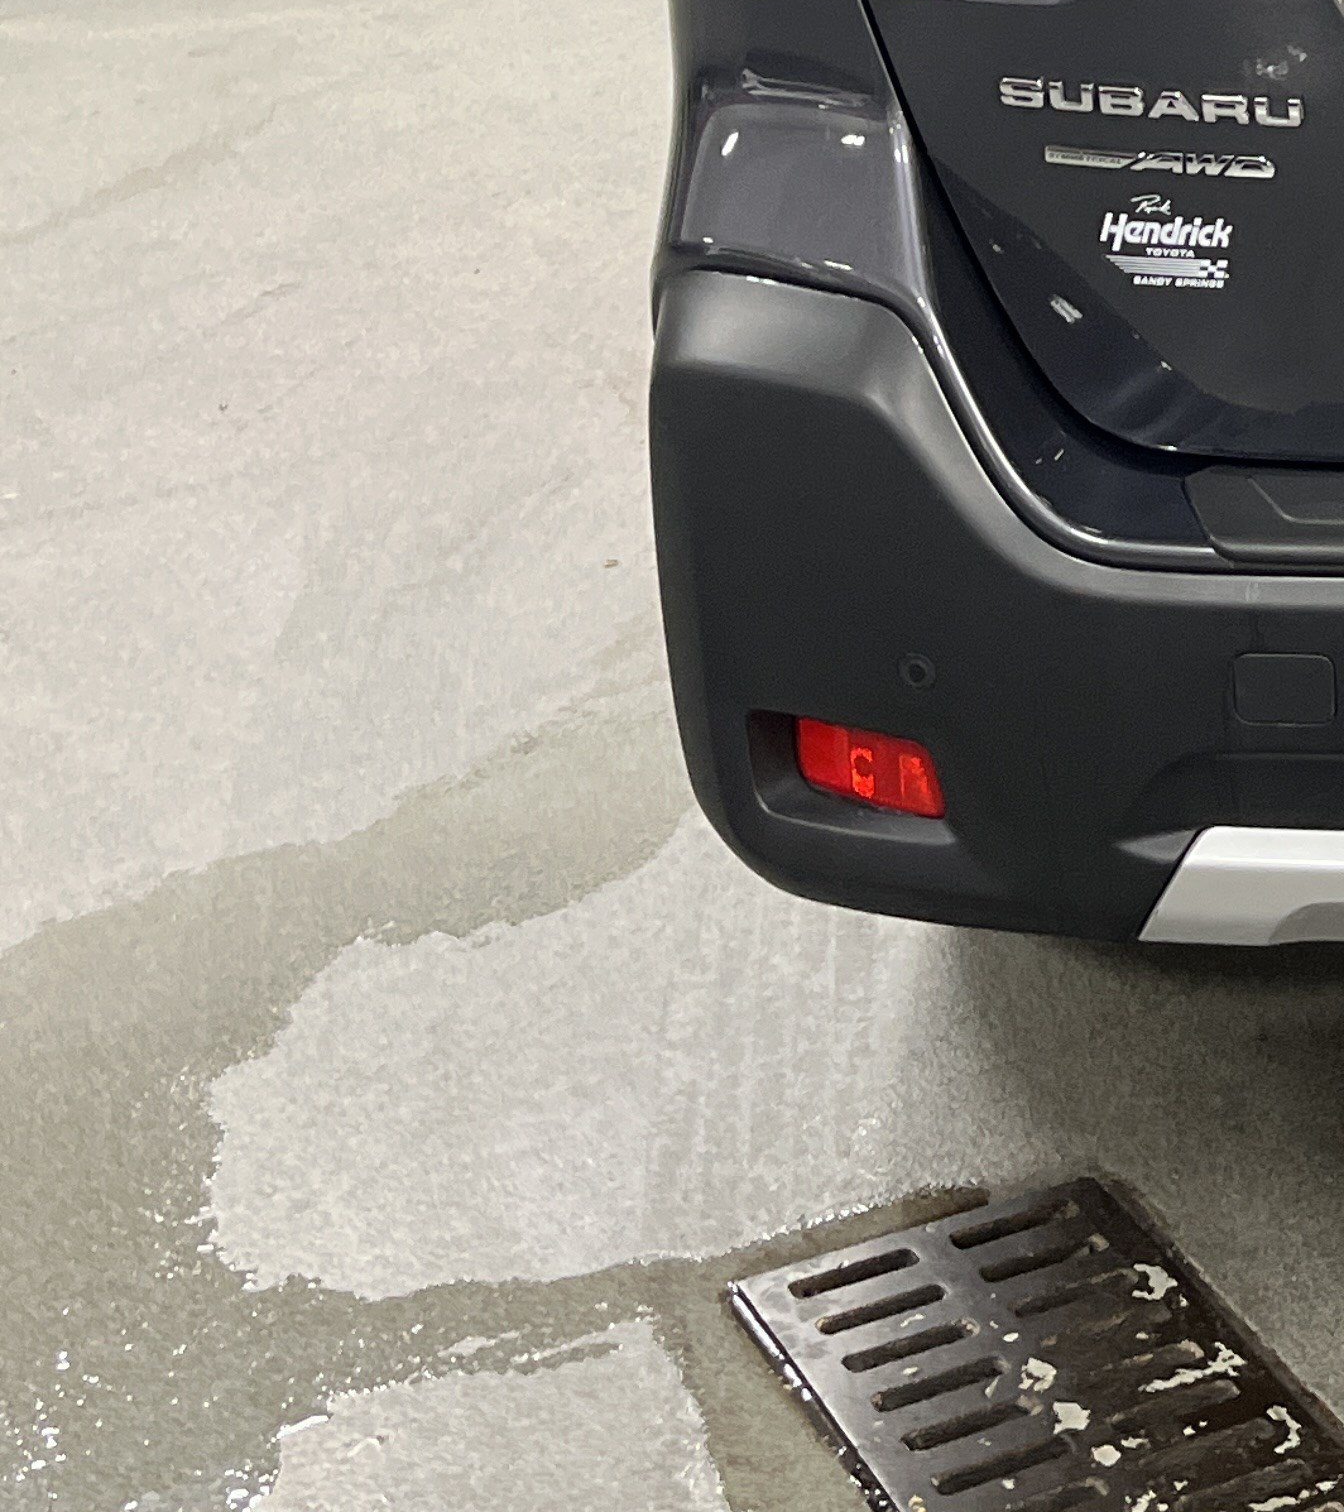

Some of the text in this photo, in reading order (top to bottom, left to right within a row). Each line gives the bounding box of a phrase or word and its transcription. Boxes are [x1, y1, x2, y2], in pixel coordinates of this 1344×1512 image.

[999, 76, 1304, 128] SUBARU
[1130, 150, 1276, 179] AWD
[1099, 211, 1233, 252] Hendrick
[1145, 247, 1196, 259] TOYOTA
[1132, 274, 1225, 289] SANDY SPRINGS
